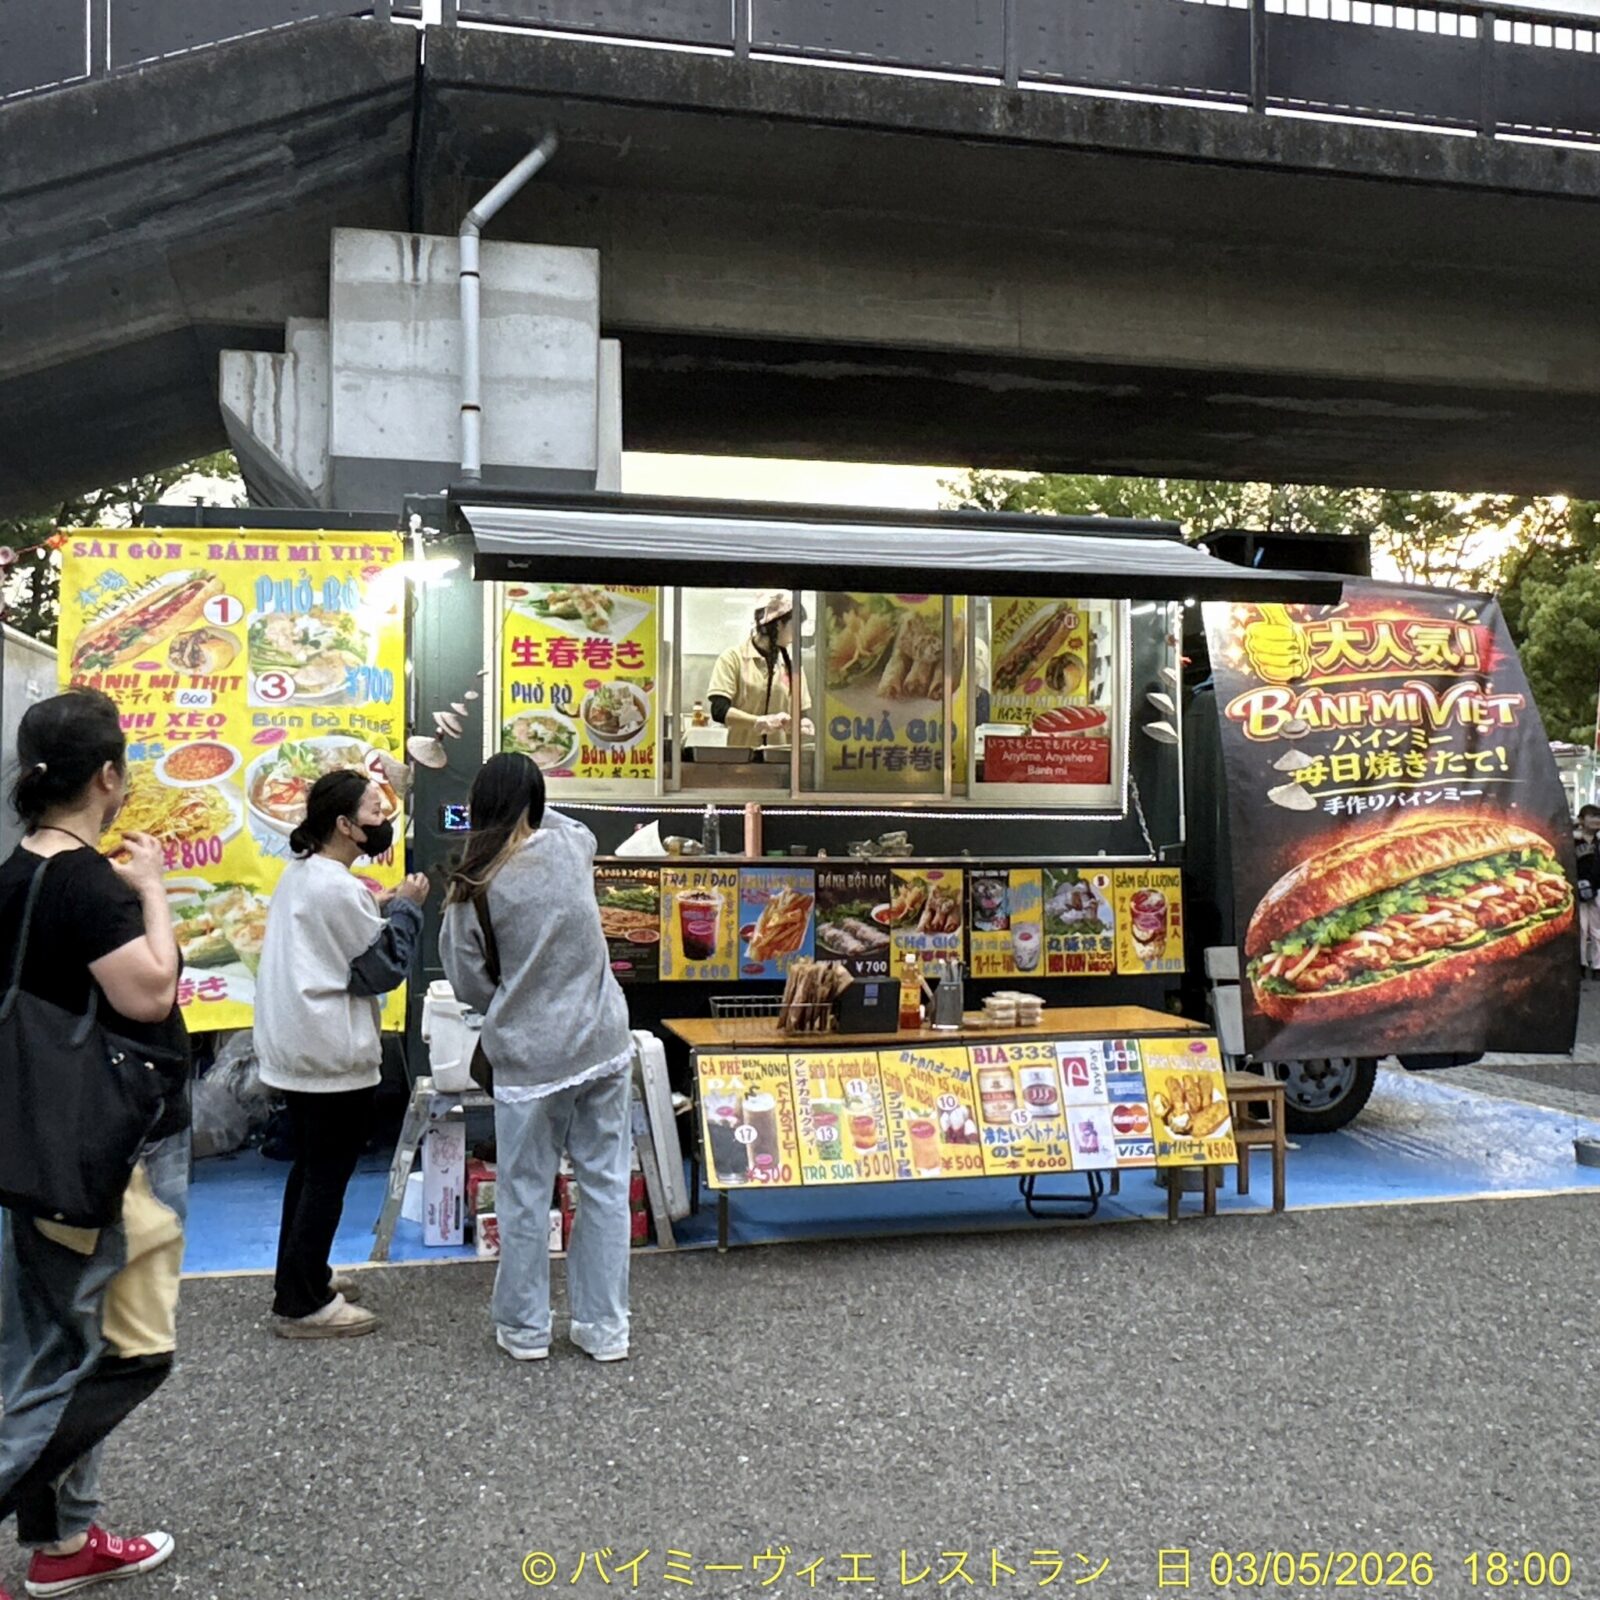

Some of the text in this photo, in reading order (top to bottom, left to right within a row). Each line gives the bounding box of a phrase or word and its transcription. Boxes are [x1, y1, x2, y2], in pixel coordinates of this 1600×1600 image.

[212, 597, 229, 623] 1
[511, 635, 646, 670] 生春巻き
[260, 672, 288, 699] 3
[1332, 728, 1453, 752] バインミー
[1323, 786, 1484, 816] 手作りバインミー
[973, 1045, 1056, 1065] BIA 333
[1090, 1047, 1104, 1096] PayPay
[939, 1095, 956, 1108] 10
[1014, 1111, 1028, 1123] 15
[820, 1127, 834, 1141] 13
[991, 1143, 1063, 1159] のビール
[1118, 1145, 1157, 1157] VISA
